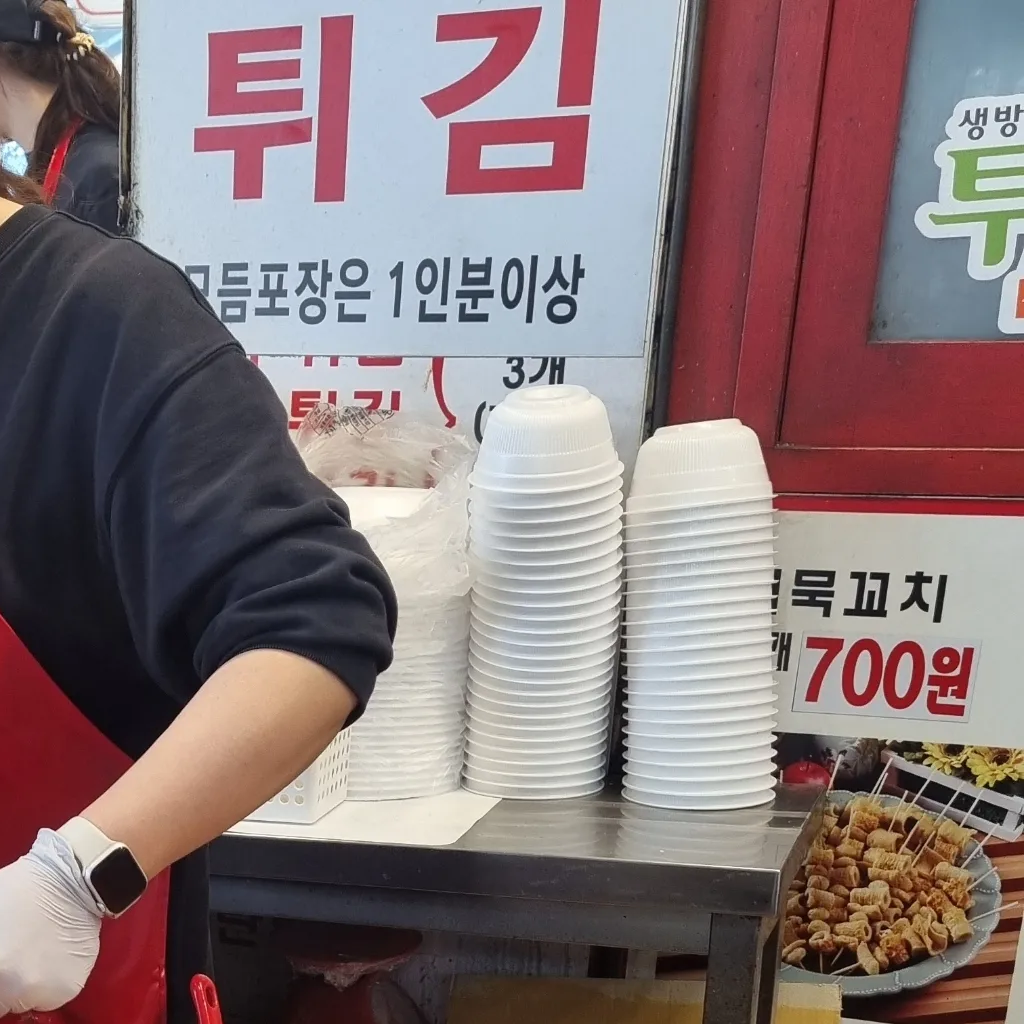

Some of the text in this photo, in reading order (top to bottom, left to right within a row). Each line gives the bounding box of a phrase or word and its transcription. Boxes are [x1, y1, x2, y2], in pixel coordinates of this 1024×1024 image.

[193, 0, 601, 203] 튀김
[388, 253, 586, 325] 1인분이상
[771, 568, 948, 623] 묵꼬치
[803, 636, 975, 717] 700원
